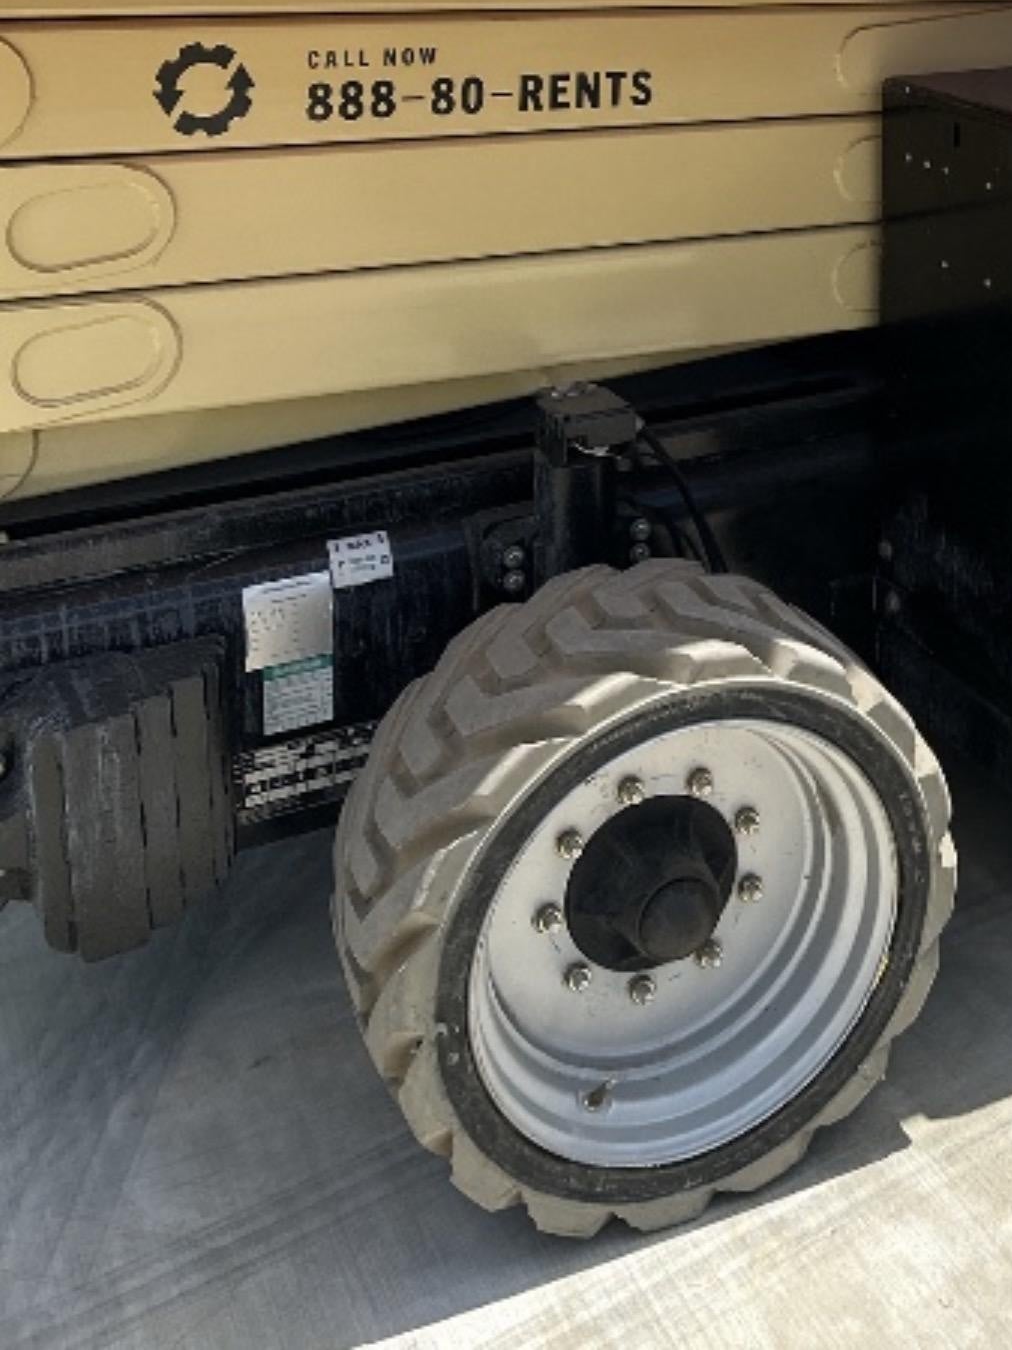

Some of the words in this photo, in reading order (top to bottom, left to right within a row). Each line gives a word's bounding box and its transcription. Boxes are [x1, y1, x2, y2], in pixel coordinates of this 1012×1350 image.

[307, 49, 371, 70] CALL
[383, 46, 438, 67] NOW
[306, 70, 653, 121] 888-80-RENTS
